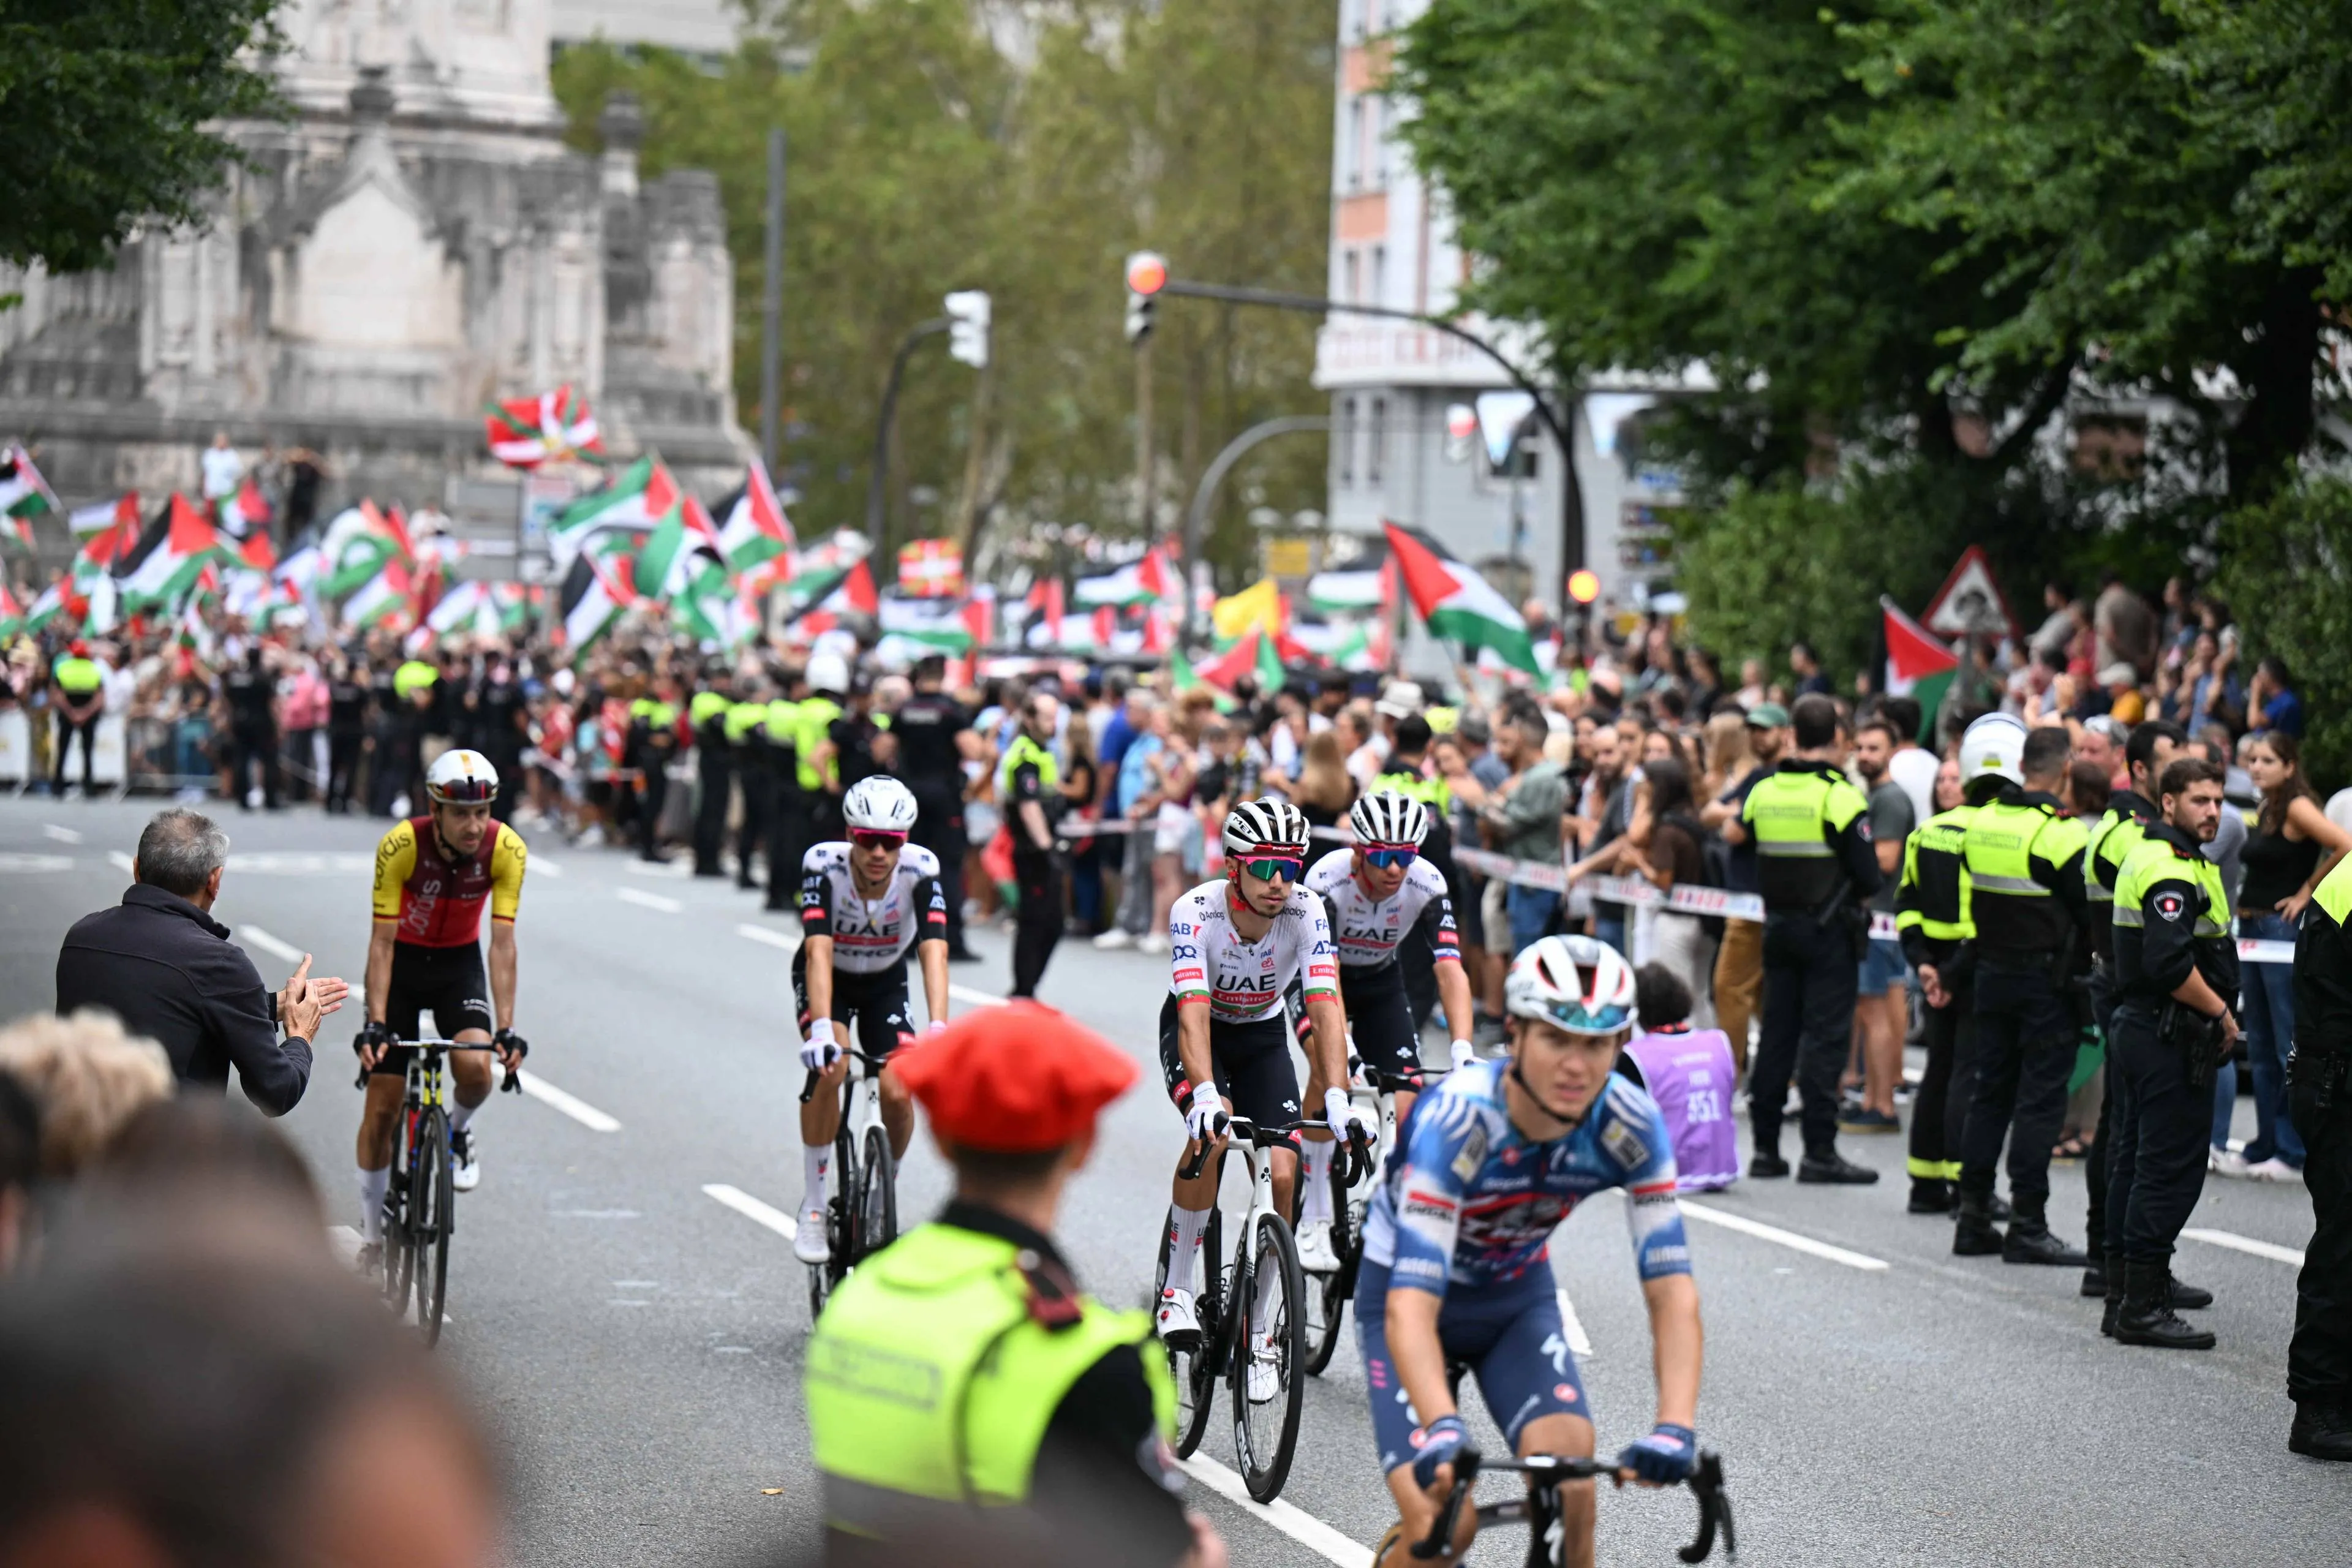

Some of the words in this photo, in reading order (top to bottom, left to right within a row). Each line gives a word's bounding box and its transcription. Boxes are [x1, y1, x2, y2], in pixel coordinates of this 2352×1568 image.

[1233, 816, 1254, 835] MET
[1205, 910, 1225, 920] Analog
[836, 920, 899, 937] UAE
[1343, 927, 1398, 942] UAE
[1261, 949, 1272, 959] FAB
[1215, 973, 1276, 992] UAE
